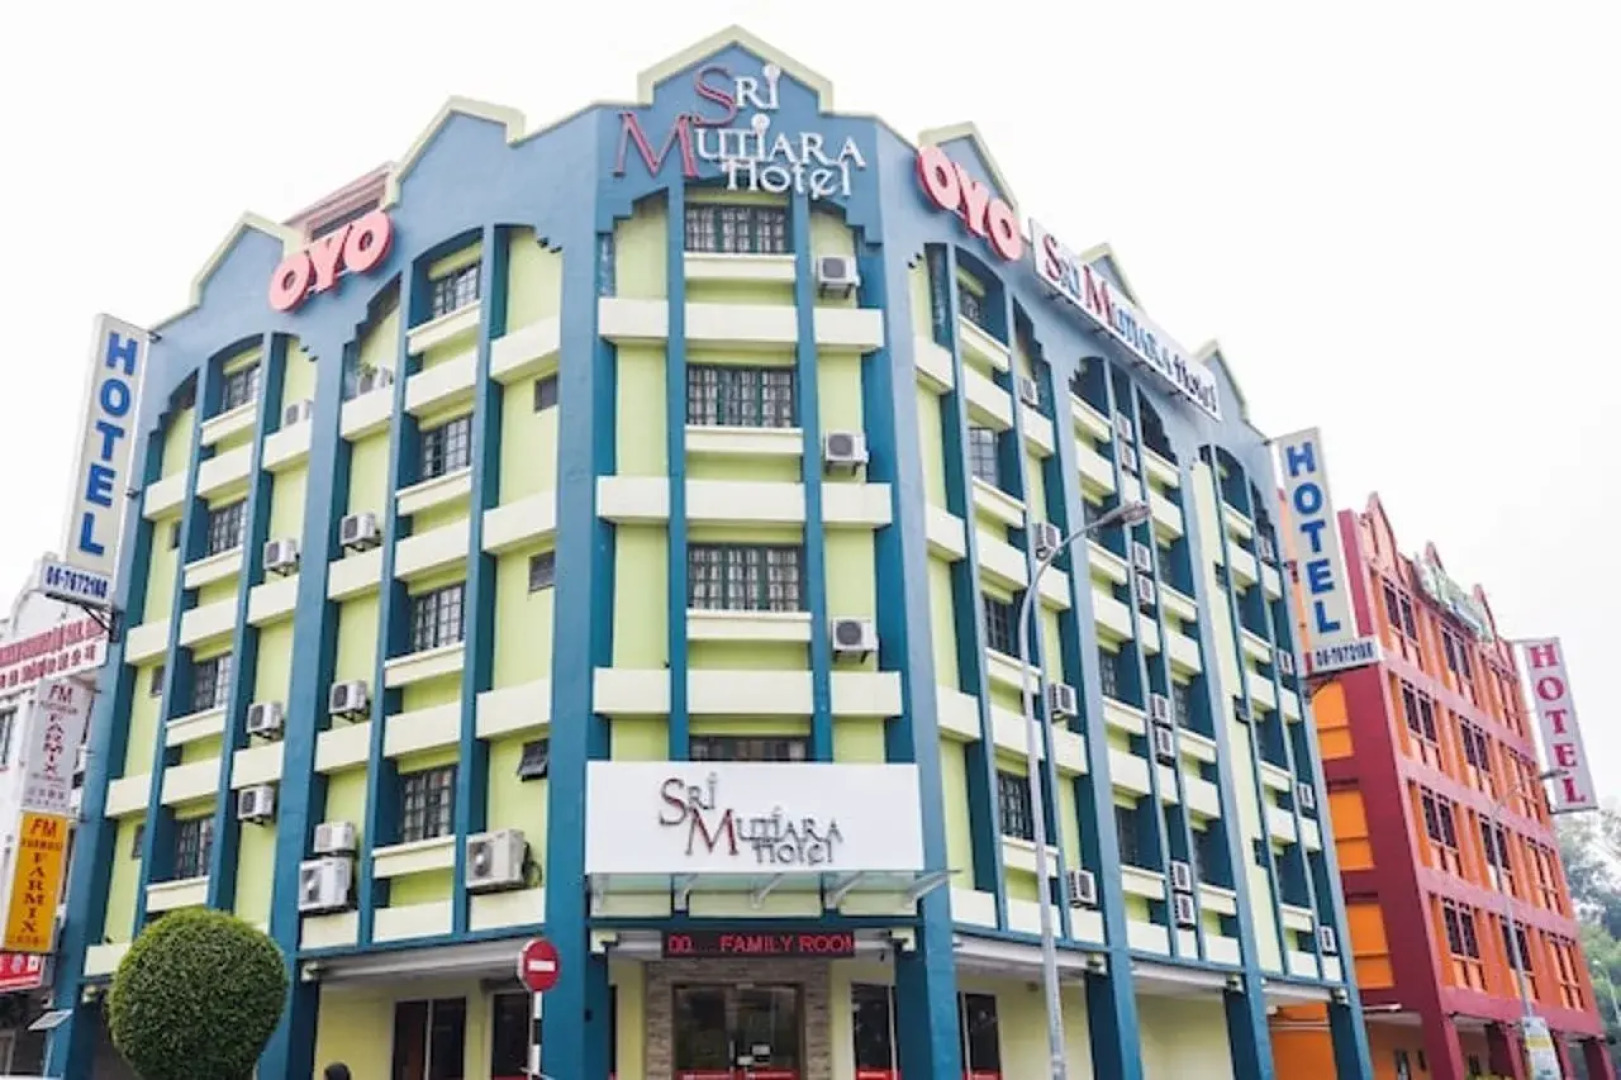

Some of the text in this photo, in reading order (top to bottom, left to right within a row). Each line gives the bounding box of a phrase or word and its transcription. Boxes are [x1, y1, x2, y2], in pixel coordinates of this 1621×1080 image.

[917, 145, 1023, 262] OYO
[269, 210, 392, 312] OYO
[77, 330, 138, 557] HOTEL
[1286, 441, 1341, 634] HOTEL
[48, 684, 74, 704] FM
[1528, 642, 1588, 804] HOTEL
[29, 818, 57, 839] FM
[719, 934, 793, 952] FAMILY
